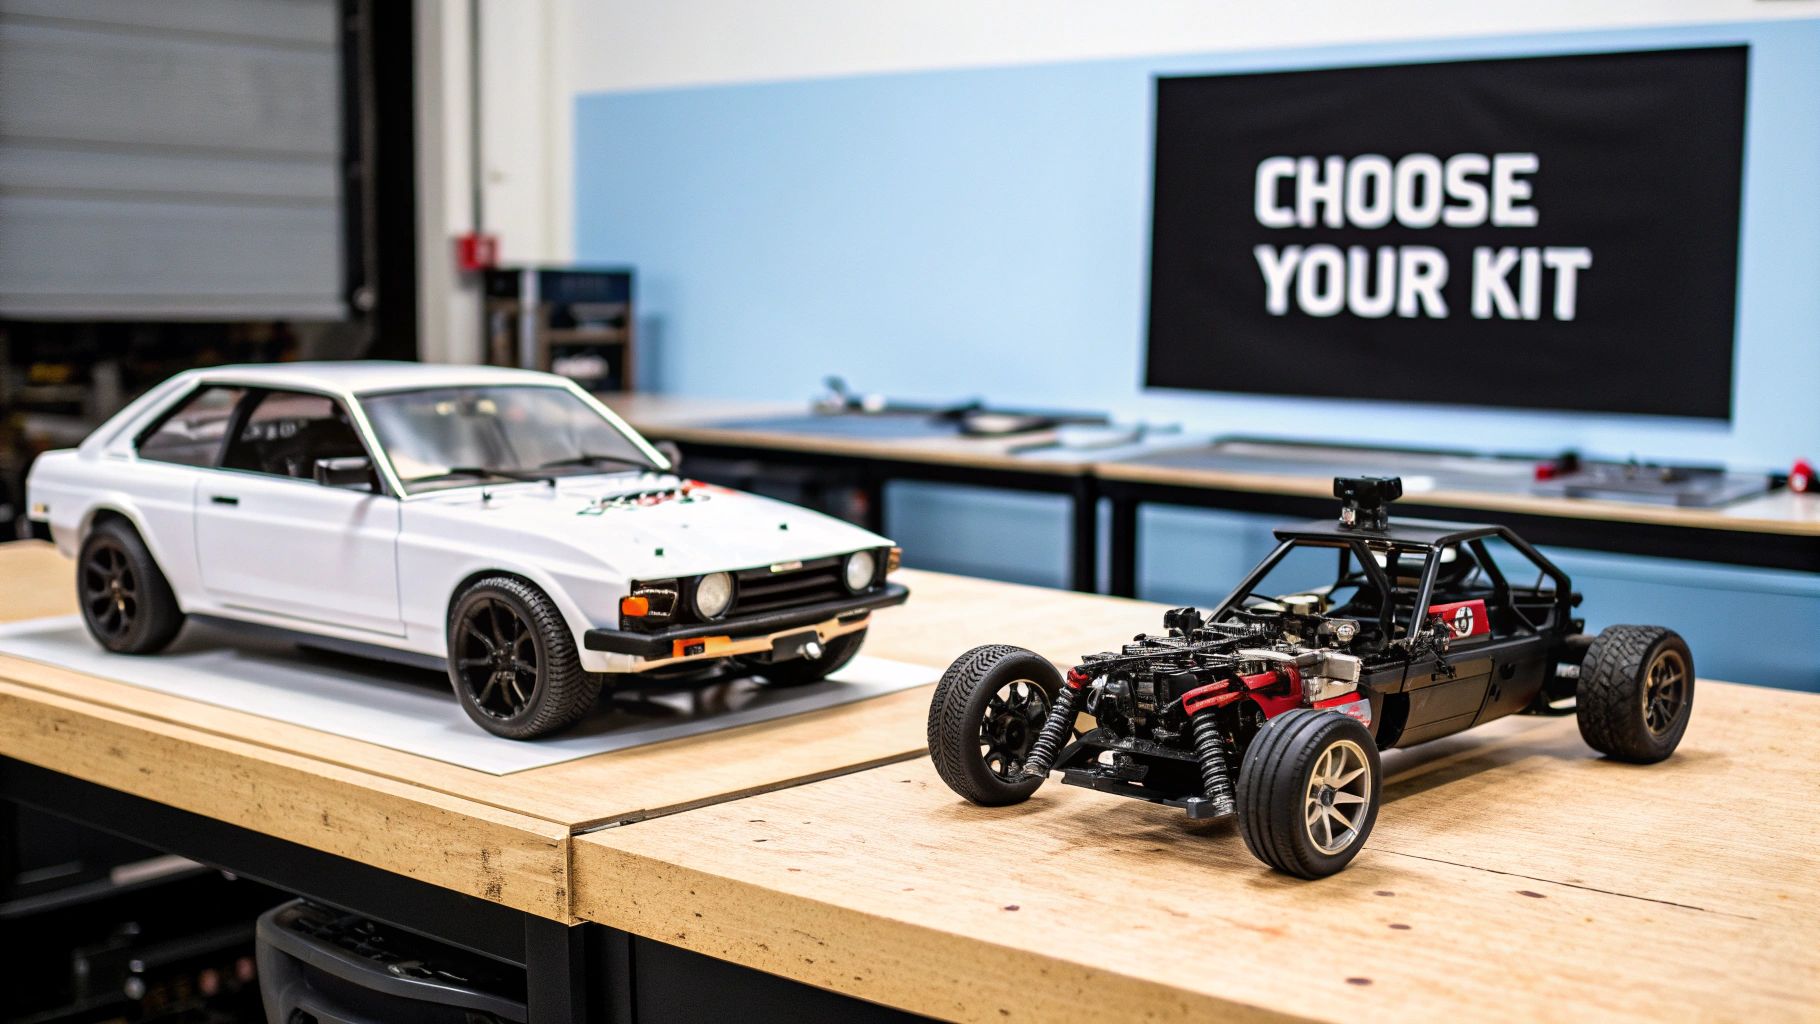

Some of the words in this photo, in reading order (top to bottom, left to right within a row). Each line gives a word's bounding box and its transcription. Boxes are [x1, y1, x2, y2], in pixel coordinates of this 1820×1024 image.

[1254, 153, 1539, 229] CHOOSE
[1254, 244, 1449, 319] YOUR
[1471, 246, 1593, 321] KIT
